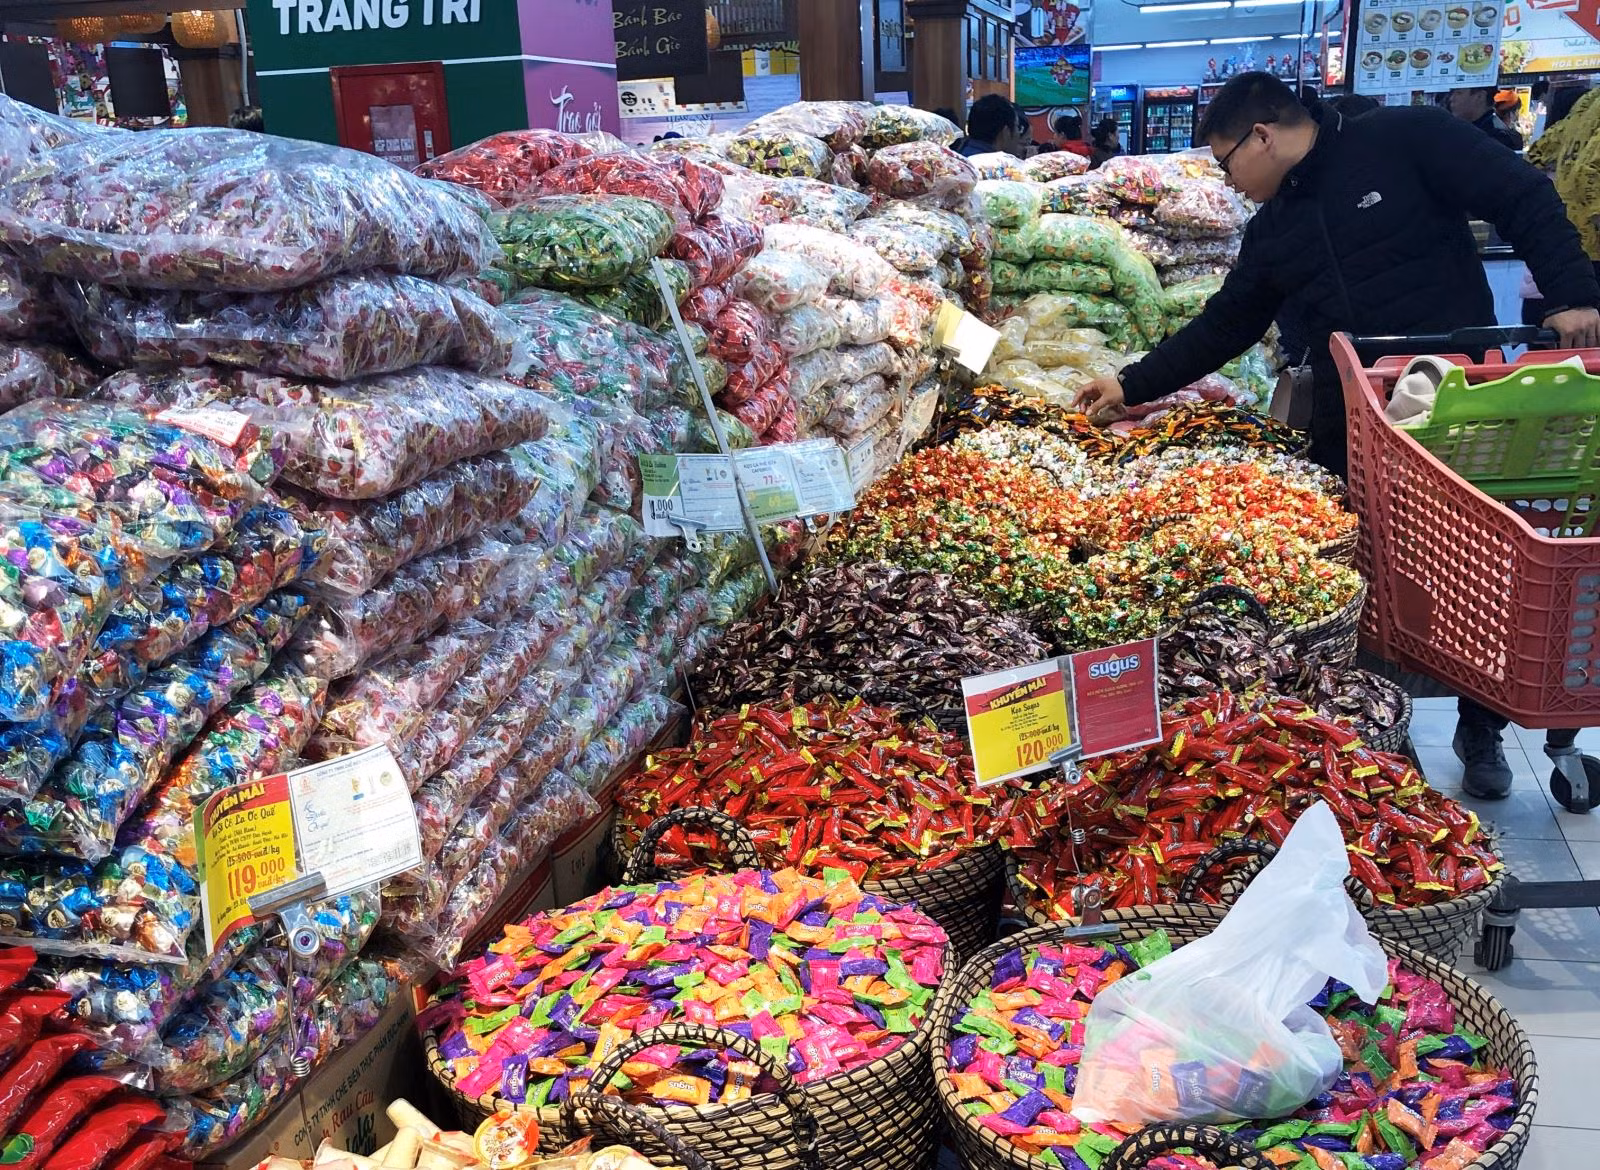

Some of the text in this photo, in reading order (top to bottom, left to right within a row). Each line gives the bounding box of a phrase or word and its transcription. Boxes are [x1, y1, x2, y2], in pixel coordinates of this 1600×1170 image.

[272, 0, 410, 35] TRANG
[652, 8, 682, 26] Bao
[1090, 655, 1139, 677] sugus
[990, 686, 1028, 710] KHUYẾN
[487, 970, 511, 988] sugus
[668, 1080, 696, 1091] sugus
[330, 1105, 354, 1134] Rau
